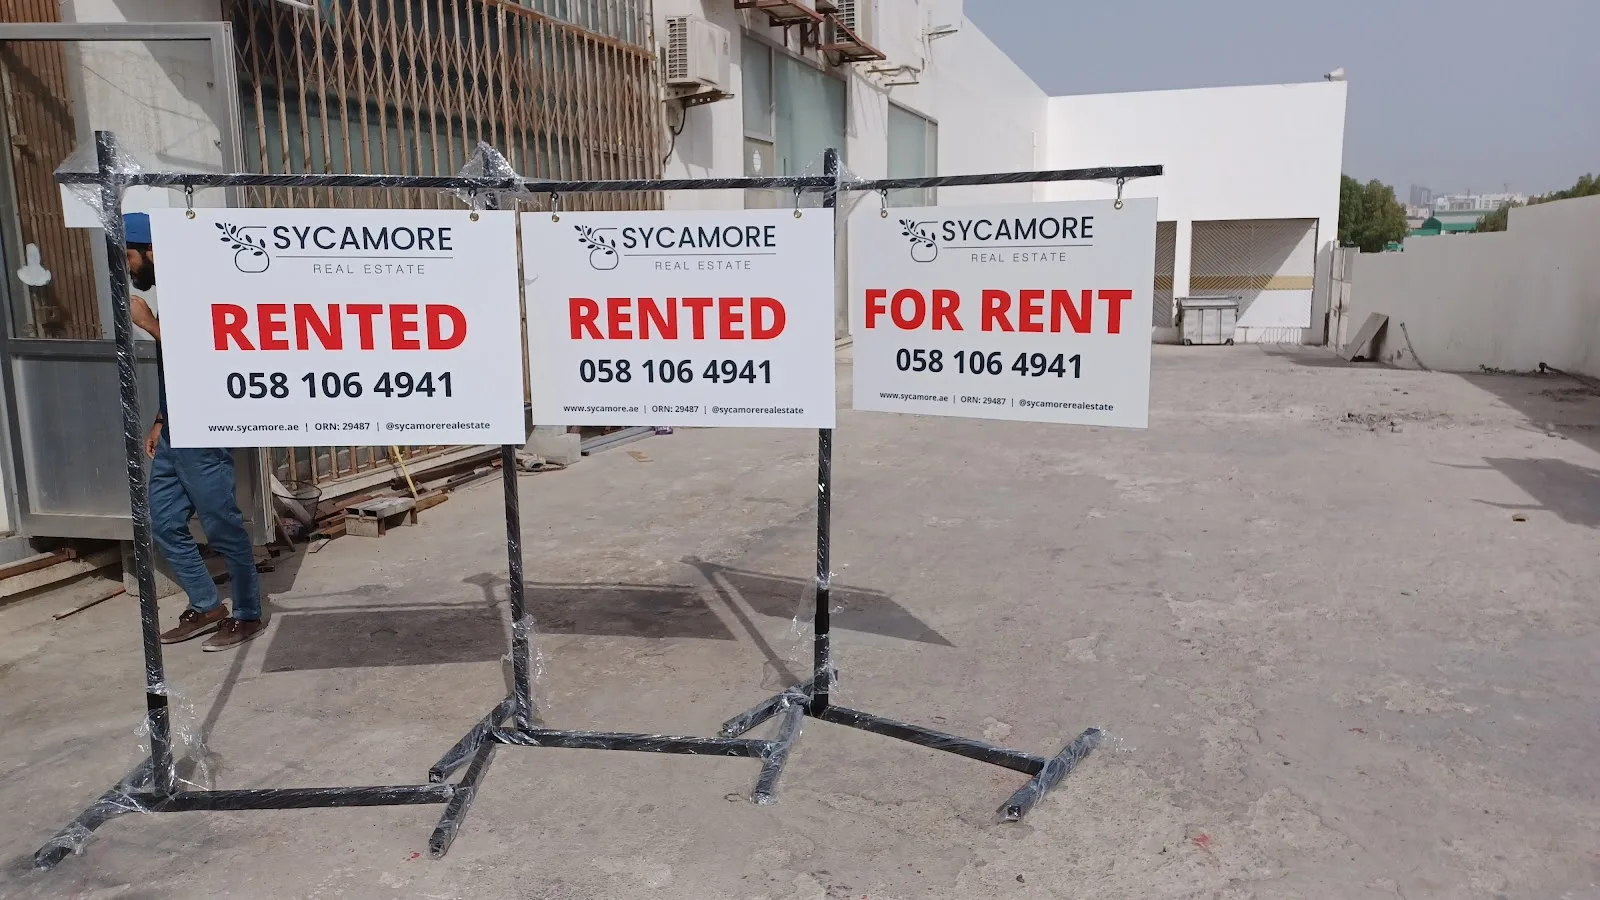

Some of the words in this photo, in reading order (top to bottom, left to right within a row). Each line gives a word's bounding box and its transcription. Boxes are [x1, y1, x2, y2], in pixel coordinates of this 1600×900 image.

[273, 226, 452, 250] SYCAMORE
[623, 226, 775, 248] SYCAMORE
[943, 216, 1093, 241] SYCAMORE
[313, 263, 354, 274] REAL
[363, 264, 425, 275] ESTATE
[655, 261, 690, 271] REAL
[697, 260, 751, 271] ESTATE
[971, 253, 1005, 263] REAL
[1012, 252, 1066, 263] ESTATE
[569, 297, 786, 339] RENTED
[866, 289, 963, 330] FOR
[981, 290, 1132, 334] RENT
[211, 304, 467, 350] RENTED
[580, 359, 631, 383] 058
[642, 360, 693, 383] 106
[703, 360, 770, 383] 4941
[897, 348, 943, 372] 058
[954, 351, 1002, 375] 106
[1012, 353, 1080, 378] 4941
[227, 372, 289, 399] 058
[302, 372, 362, 398] 106
[374, 372, 451, 397] 4941
[563, 405, 639, 414] www.sycamore.ae
[651, 405, 673, 413] ORN:
[674, 405, 699, 413] 29487
[711, 405, 804, 415] @sycamorerealestate
[879, 392, 949, 402] www.sycamore.ae
[960, 395, 981, 404] ORN:
[982, 396, 1007, 405] 29487
[1019, 398, 1114, 411] @sycamorerealestate
[207, 424, 299, 434] www.sycamore.ae
[314, 422, 340, 431] ORN:
[342, 422, 371, 431] 29487
[385, 421, 491, 432] @sycamorerealestate
